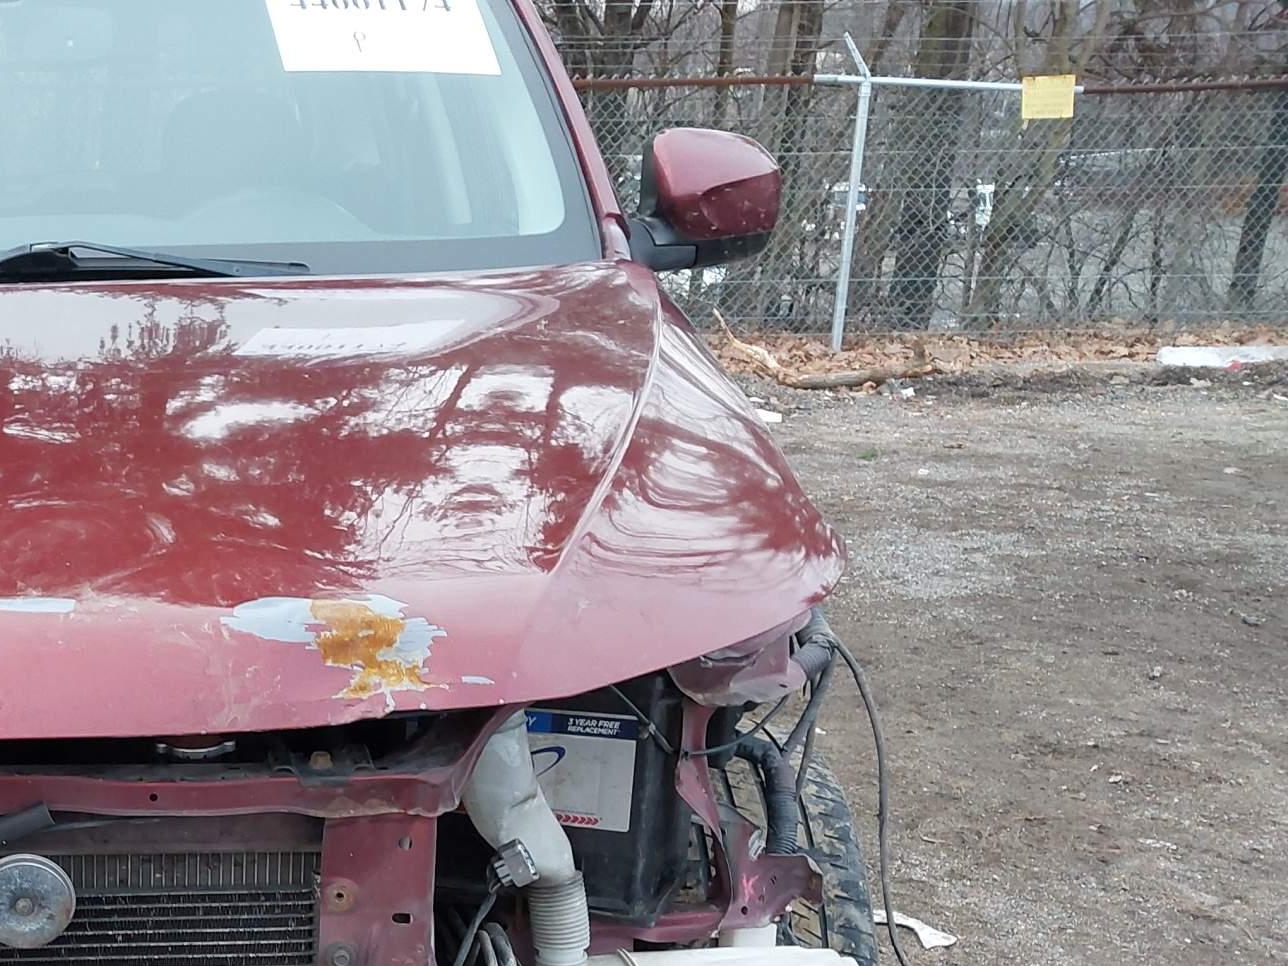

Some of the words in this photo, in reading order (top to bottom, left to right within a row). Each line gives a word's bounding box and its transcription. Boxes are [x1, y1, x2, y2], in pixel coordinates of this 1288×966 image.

[567, 717, 575, 726] 3
[575, 718, 598, 728] YEAR
[598, 719, 621, 729] FREE
[567, 725, 618, 736] REPLACEMENT
